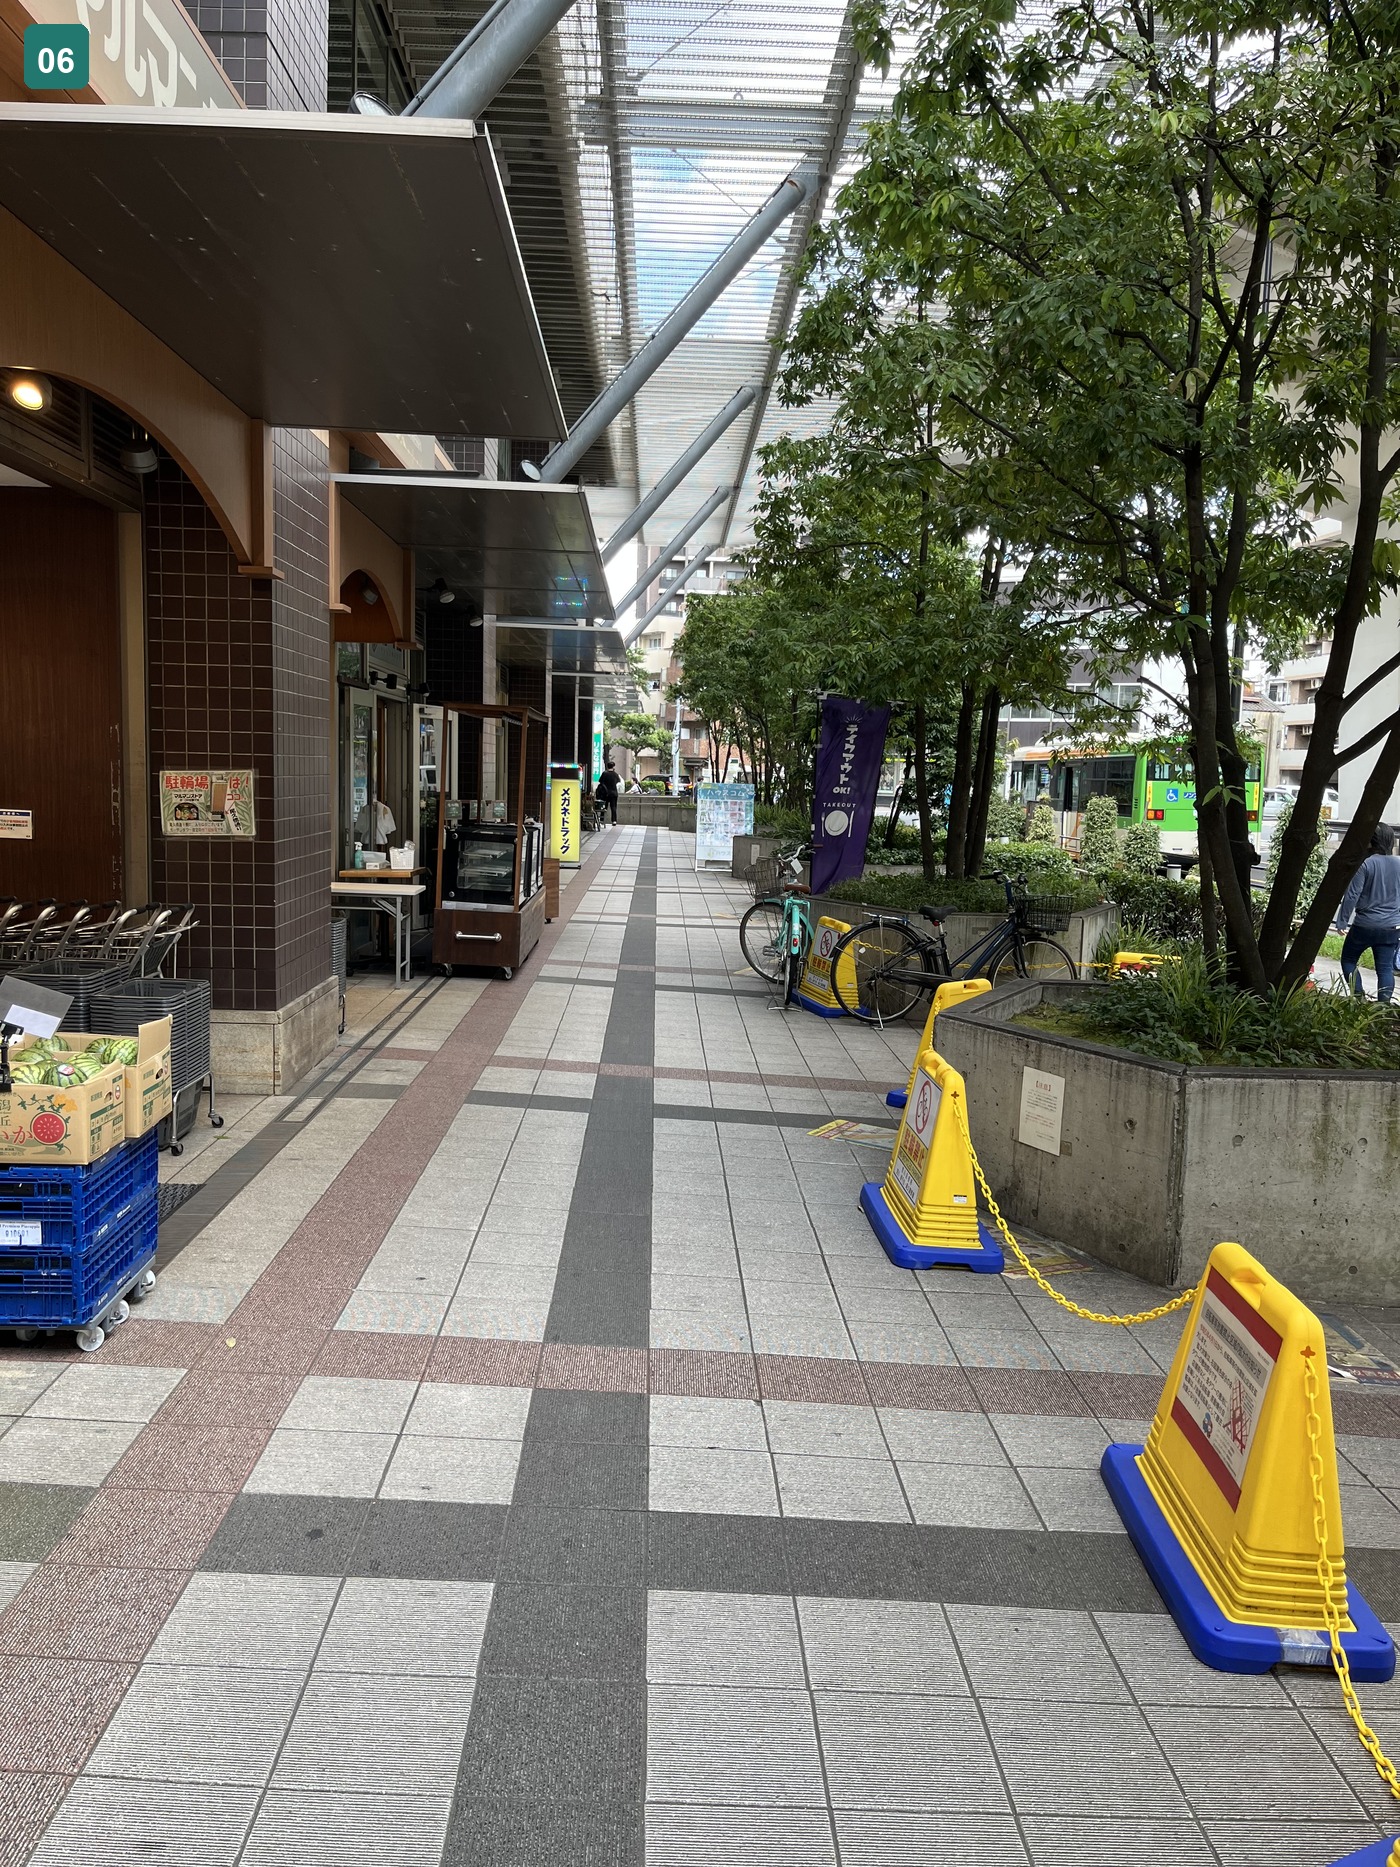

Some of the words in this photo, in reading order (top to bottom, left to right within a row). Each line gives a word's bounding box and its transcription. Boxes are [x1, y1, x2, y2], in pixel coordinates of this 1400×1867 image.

[839, 724, 859, 785] テイクアウト
[165, 775, 209, 790] 駐輪場
[707, 789, 745, 797] ハウスコム
[832, 786, 851, 795] OK!
[560, 787, 571, 855] メガネドラッグ
[903, 1127, 925, 1169] 駐輪禁止
